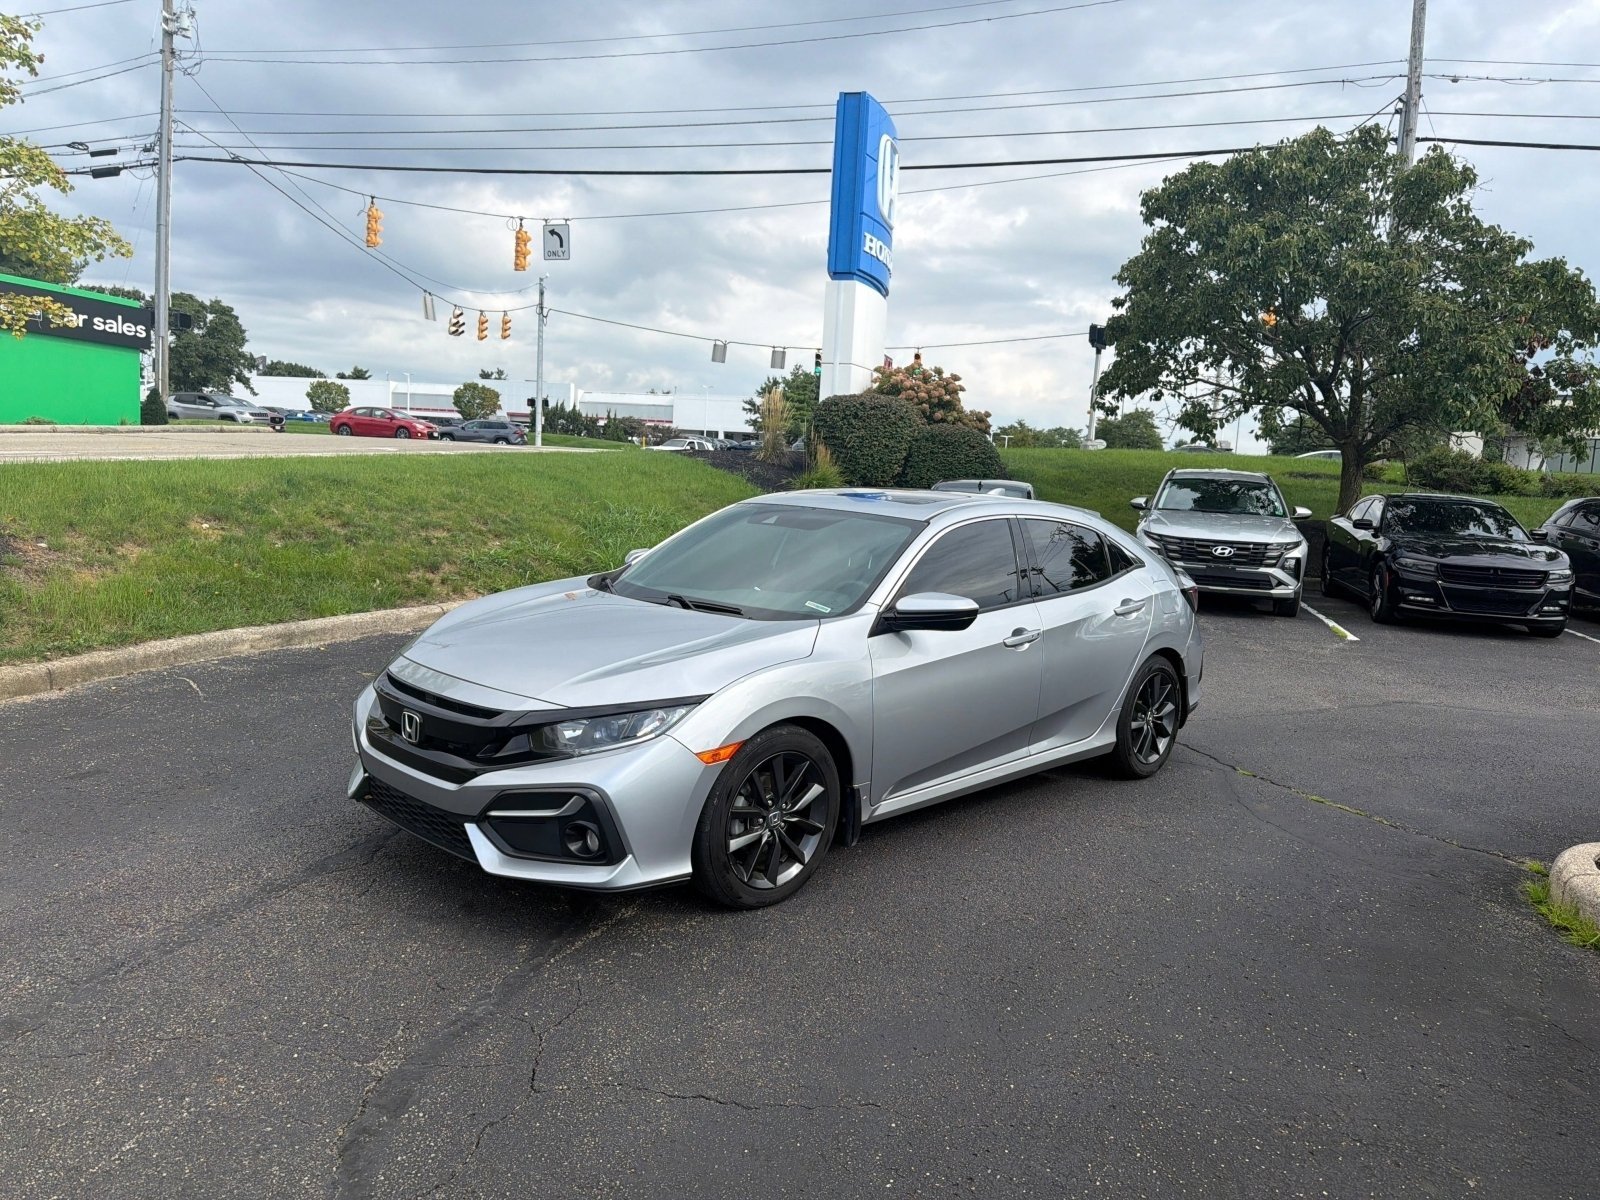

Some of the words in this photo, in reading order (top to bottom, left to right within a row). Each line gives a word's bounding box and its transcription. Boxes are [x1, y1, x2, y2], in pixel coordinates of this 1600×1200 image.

[547, 250, 566, 258] ONLY
[863, 231, 893, 274] HON
[93, 315, 147, 338] sales
